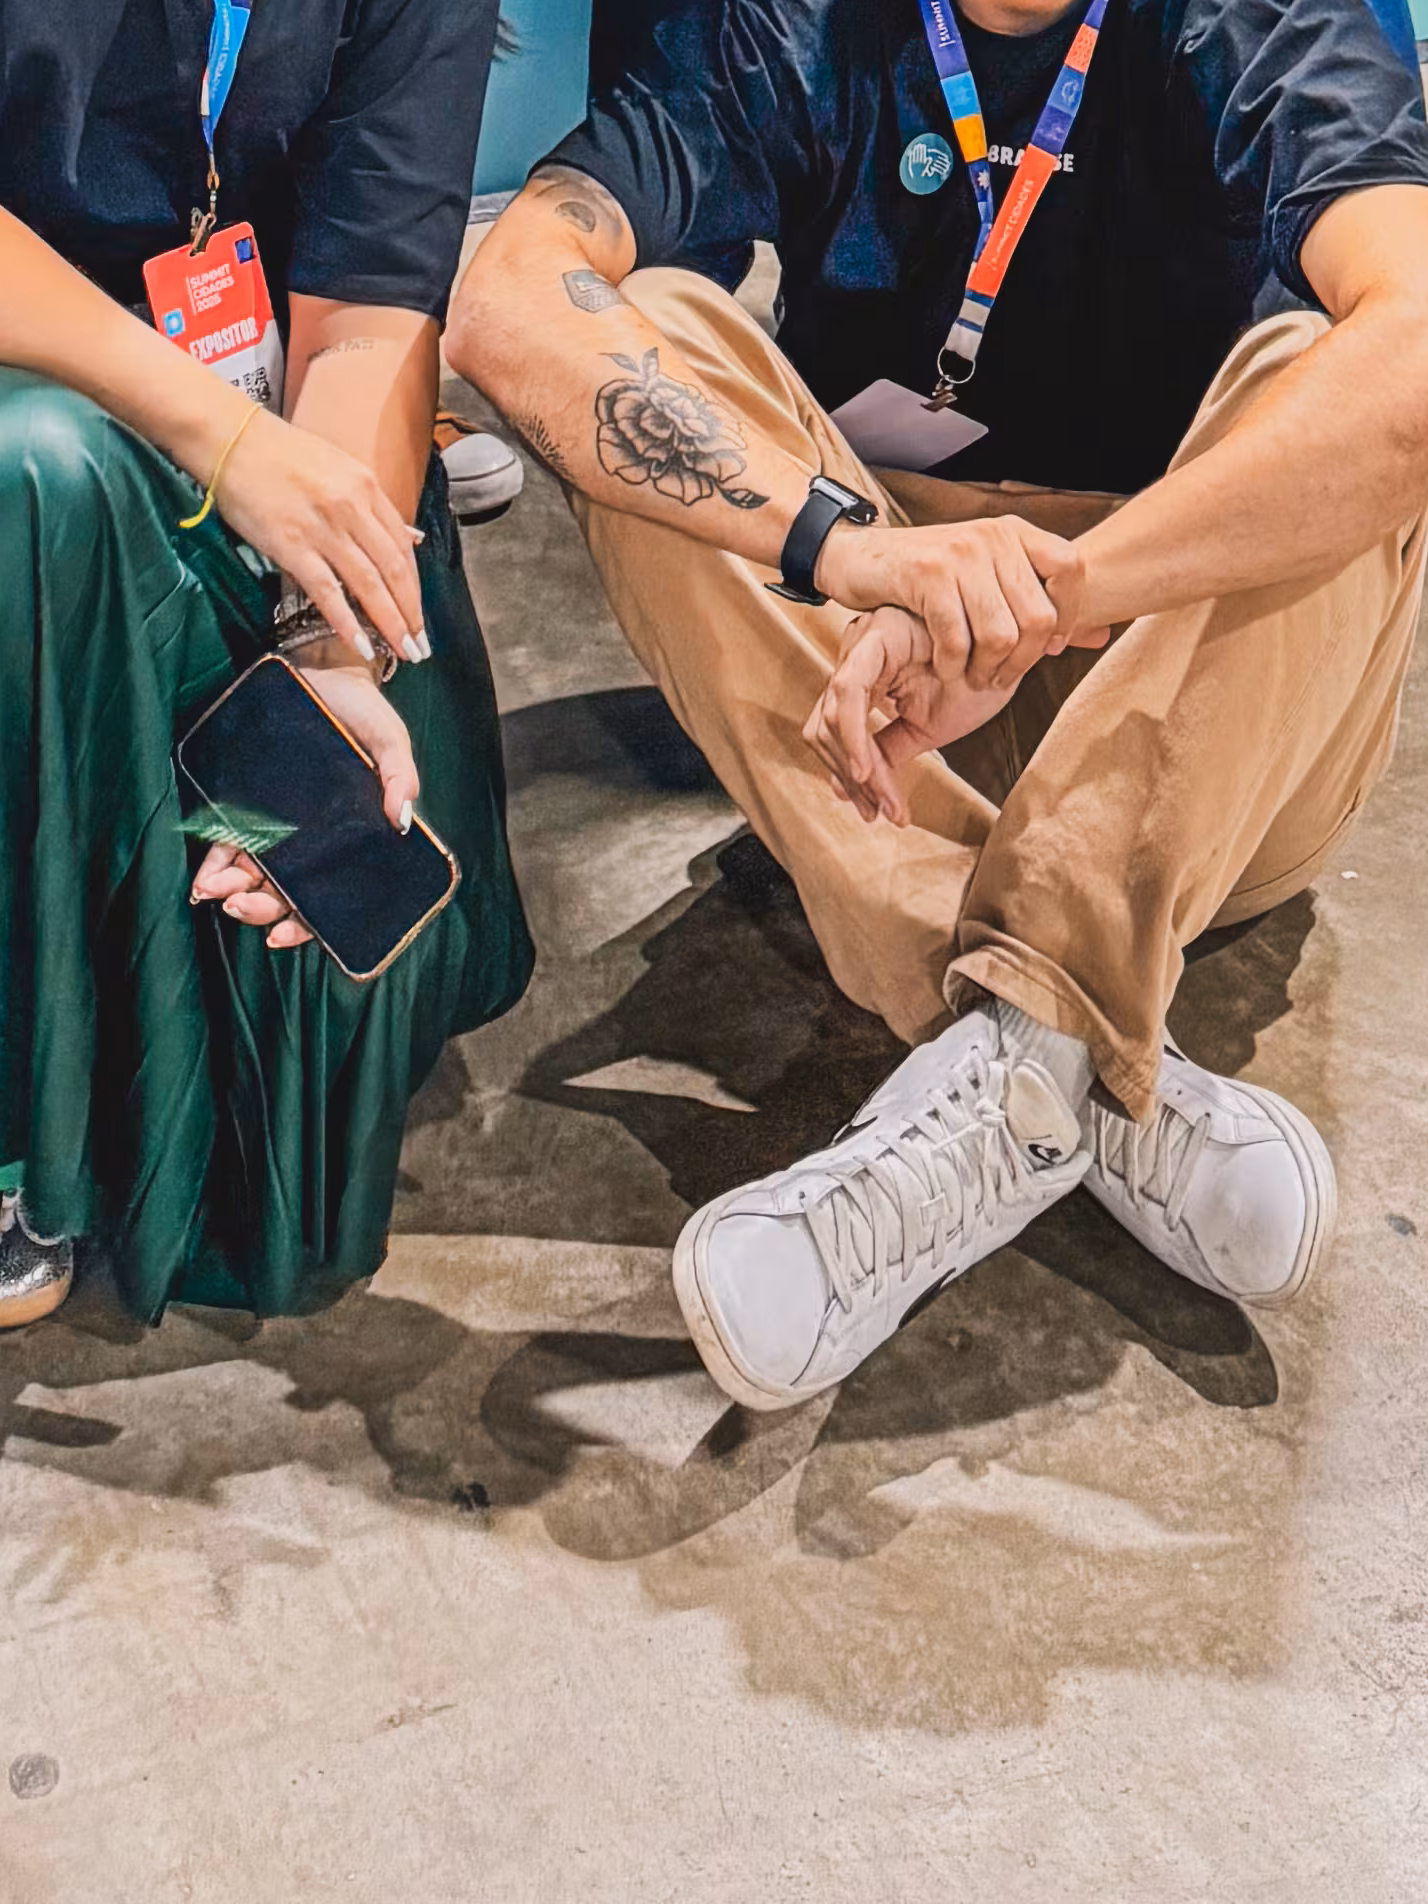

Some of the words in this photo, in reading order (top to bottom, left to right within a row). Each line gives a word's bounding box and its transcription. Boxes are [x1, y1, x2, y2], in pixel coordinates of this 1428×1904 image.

[189, 263, 231, 289] SUMMIT
[192, 275, 235, 300] CIDADES
[188, 317, 259, 362] EXPOSITOR
